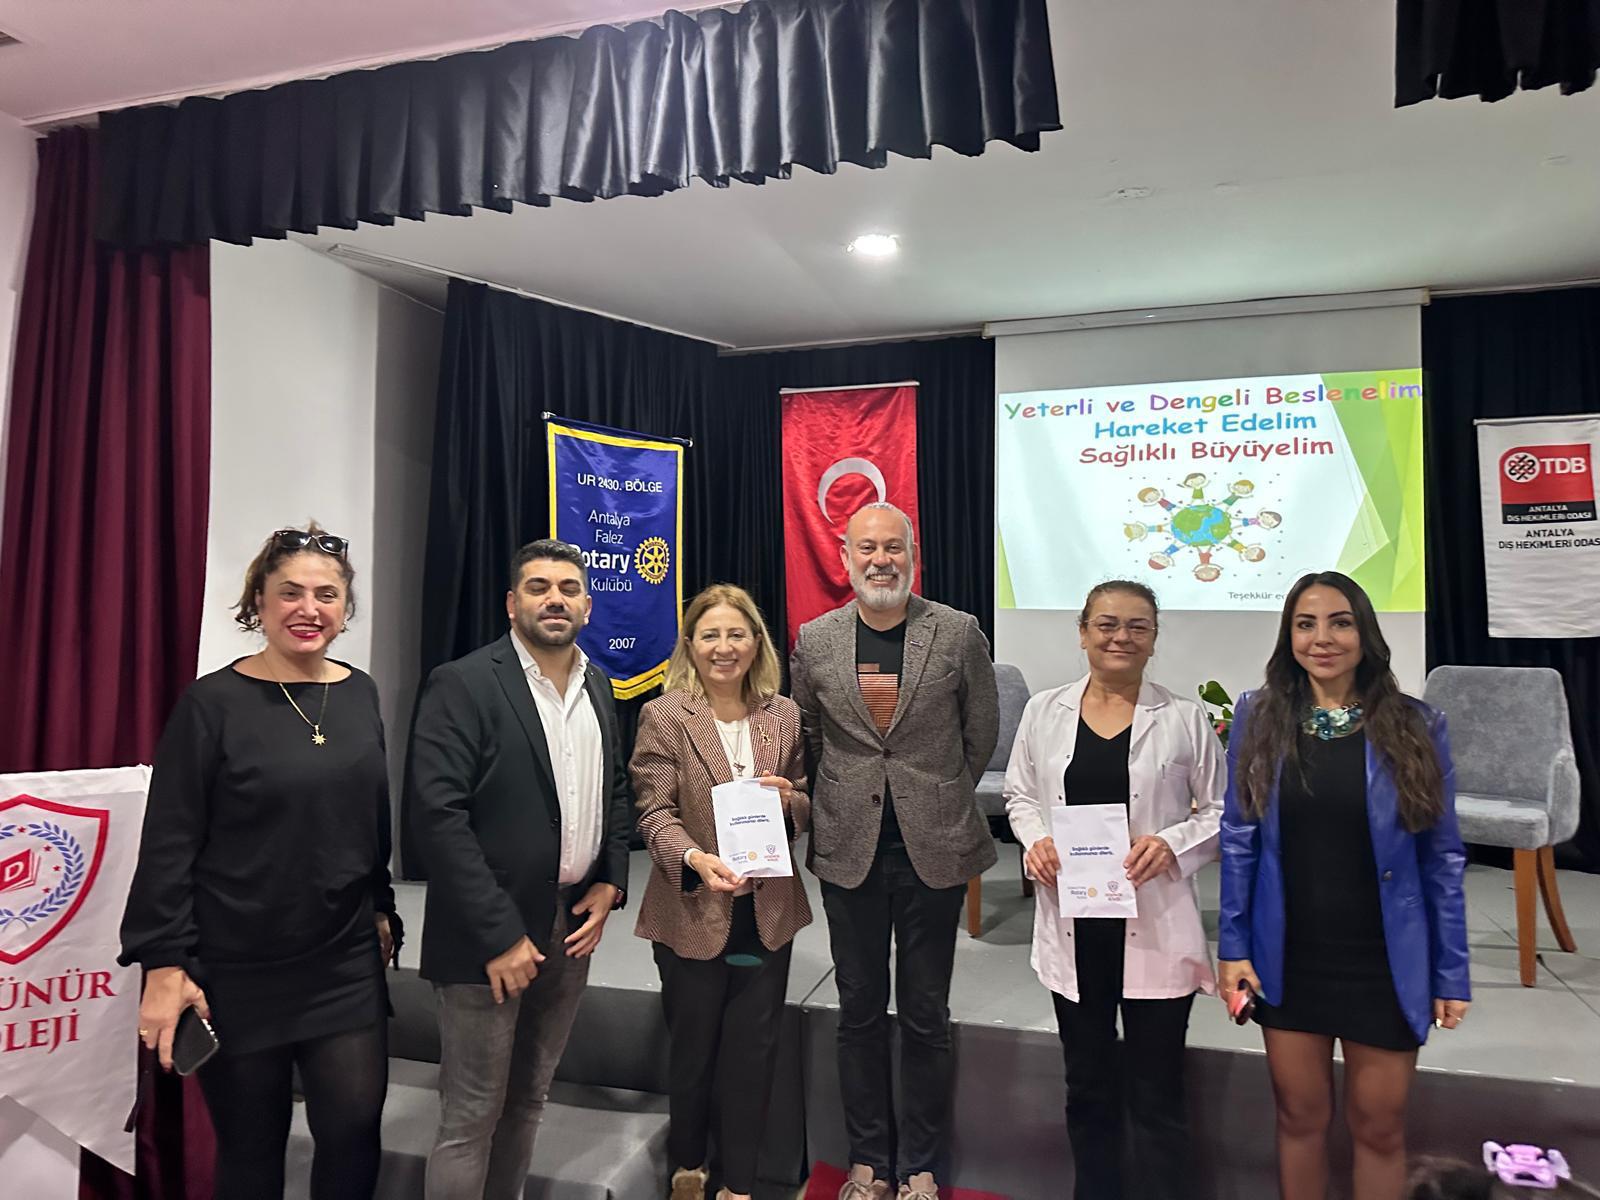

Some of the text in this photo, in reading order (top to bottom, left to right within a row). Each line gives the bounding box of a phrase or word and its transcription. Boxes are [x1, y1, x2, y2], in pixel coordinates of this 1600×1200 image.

[1004, 380, 1422, 420] Yeterli ve Dengeli Beslenelim
[1094, 412, 1317, 439] Hareket Edelim
[1079, 437, 1334, 467] Sağlıklı Büyüyelim
[1539, 457, 1587, 474] TDB
[577, 473, 663, 493] UR 2430. BÖLGE
[1528, 505, 1568, 513] ANTALYA
[588, 510, 630, 526] Antalya
[595, 529, 624, 545] Falez
[1525, 528, 1575, 538] ANTALYA
[1498, 540, 1514, 550] DİŞ
[1516, 539, 1572, 549] HEKİMLERİ
[591, 578, 632, 592] Kulübü
[1228, 590, 1274, 602] Teşekkür
[608, 638, 636, 650] 2007
